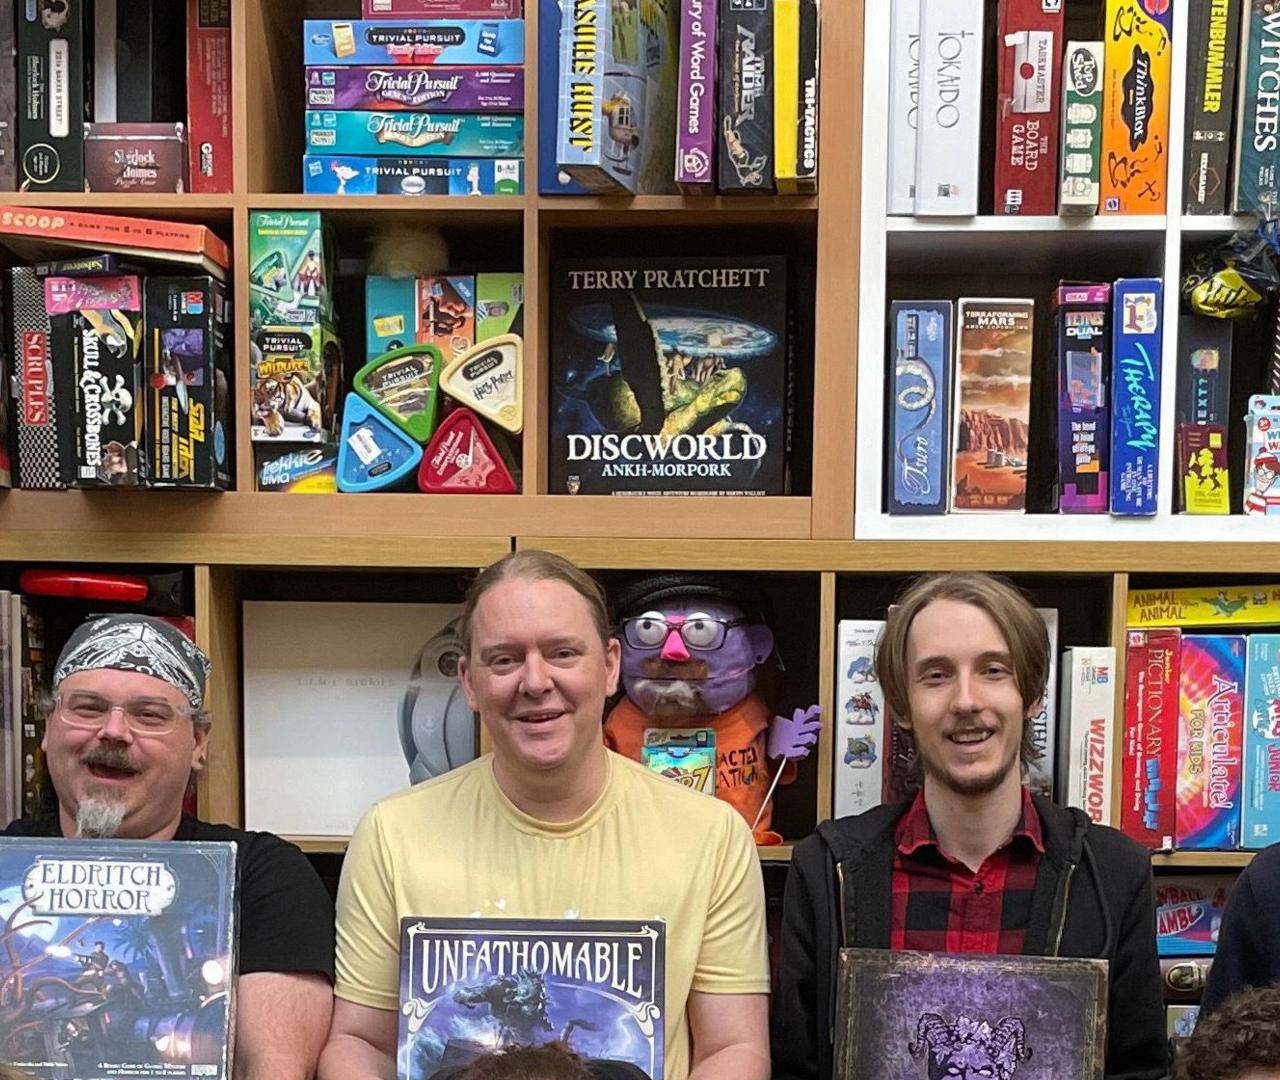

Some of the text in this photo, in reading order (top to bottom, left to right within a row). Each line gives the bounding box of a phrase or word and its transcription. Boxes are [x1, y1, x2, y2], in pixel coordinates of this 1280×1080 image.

[372, 33, 461, 43] TRIVIAL PURSUIT
[935, 29, 975, 129] TOKAIDO
[1036, 38, 1048, 105] TASKMASTER
[1070, 52, 1087, 91] Shed
[803, 77, 816, 169] TRI-TACTICS
[1011, 123, 1024, 167] GAME
[1024, 119, 1040, 172] BOARD
[365, 166, 462, 177] TRIVIAL PURSUIT
[1, 211, 65, 229] SCOOP
[568, 268, 770, 290] TERRY PRATCHETT
[965, 311, 1028, 319] TERRAFORMING
[977, 317, 1016, 327] MARS
[1065, 327, 1103, 337] DUAL
[1122, 342, 1156, 452] Therapy
[566, 433, 767, 462] DISCWORLD
[601, 462, 732, 478] ANKH-MORPORK
[1132, 591, 1178, 608] ANIMAL
[1138, 605, 1186, 623] ANIMAL
[1096, 665, 1109, 685] MB
[1147, 648, 1165, 758] PICTIONARY
[1207, 676, 1239, 810] Articulate!
[41, 862, 162, 888] ELDRITCH
[48, 888, 153, 913] HORROR
[421, 937, 644, 999] UNFATHOMABLE
